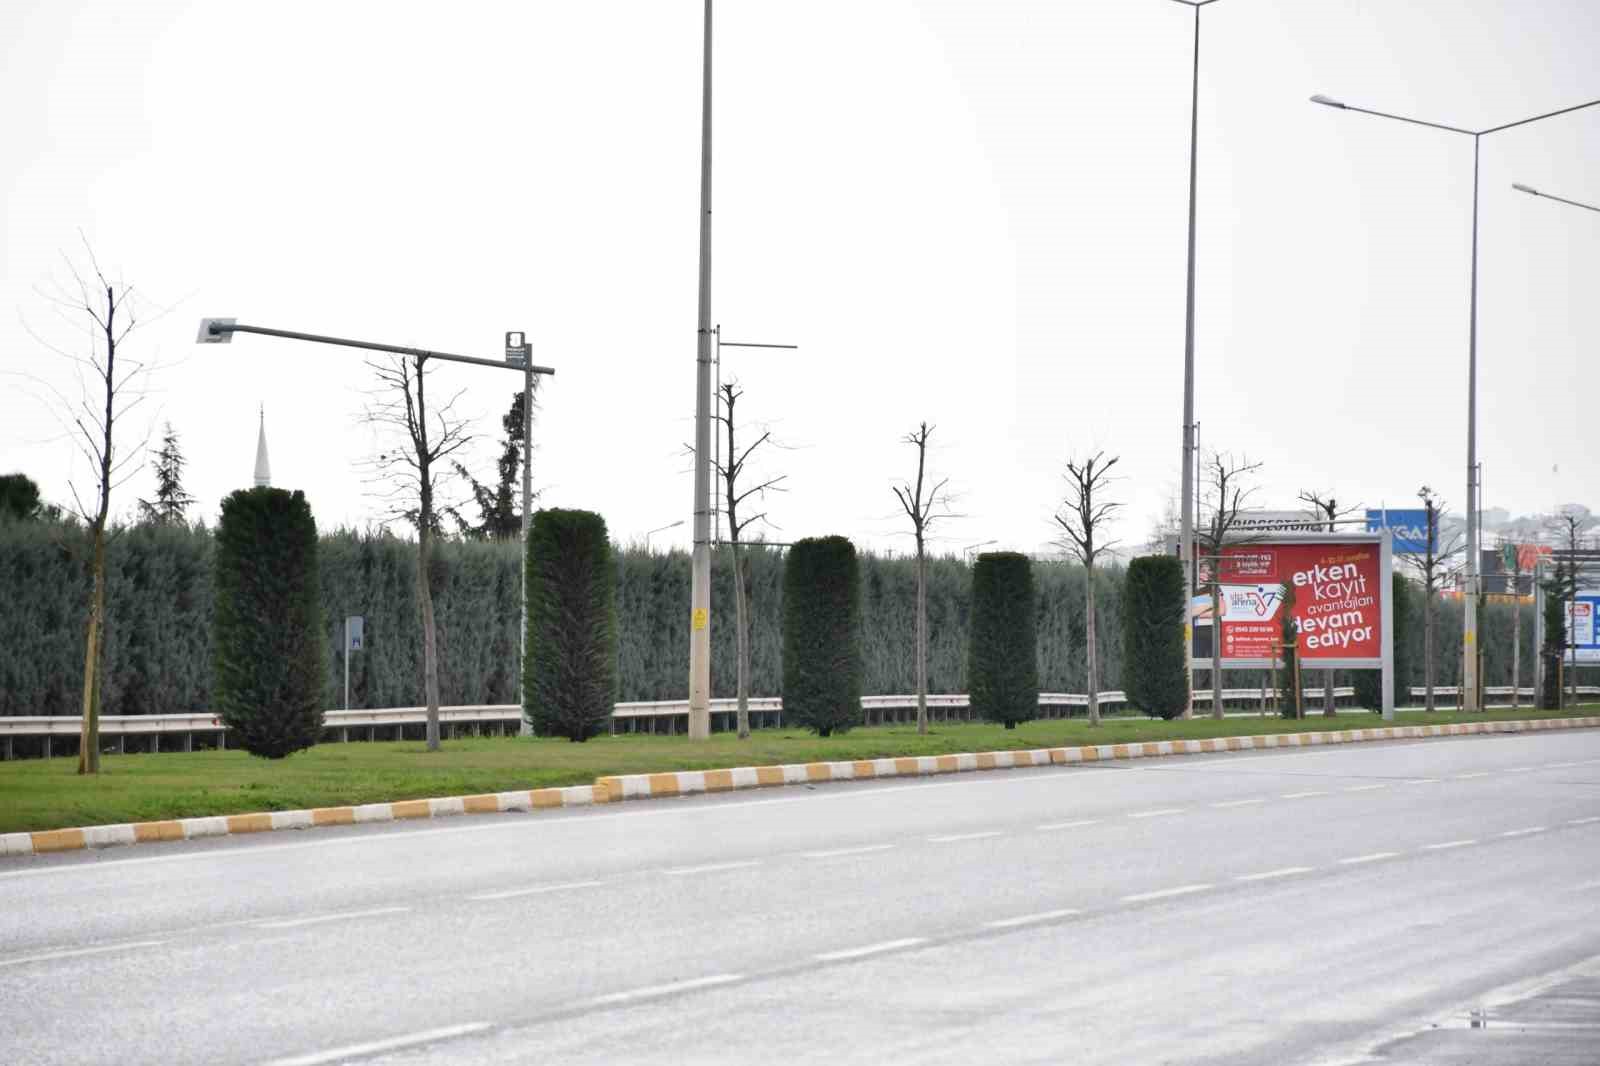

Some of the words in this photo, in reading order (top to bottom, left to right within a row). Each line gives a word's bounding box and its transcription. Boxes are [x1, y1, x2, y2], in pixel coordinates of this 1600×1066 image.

[1292, 563, 1357, 586] erken
[1313, 574, 1366, 601] kayıt
[1307, 626, 1372, 649] ediyor
